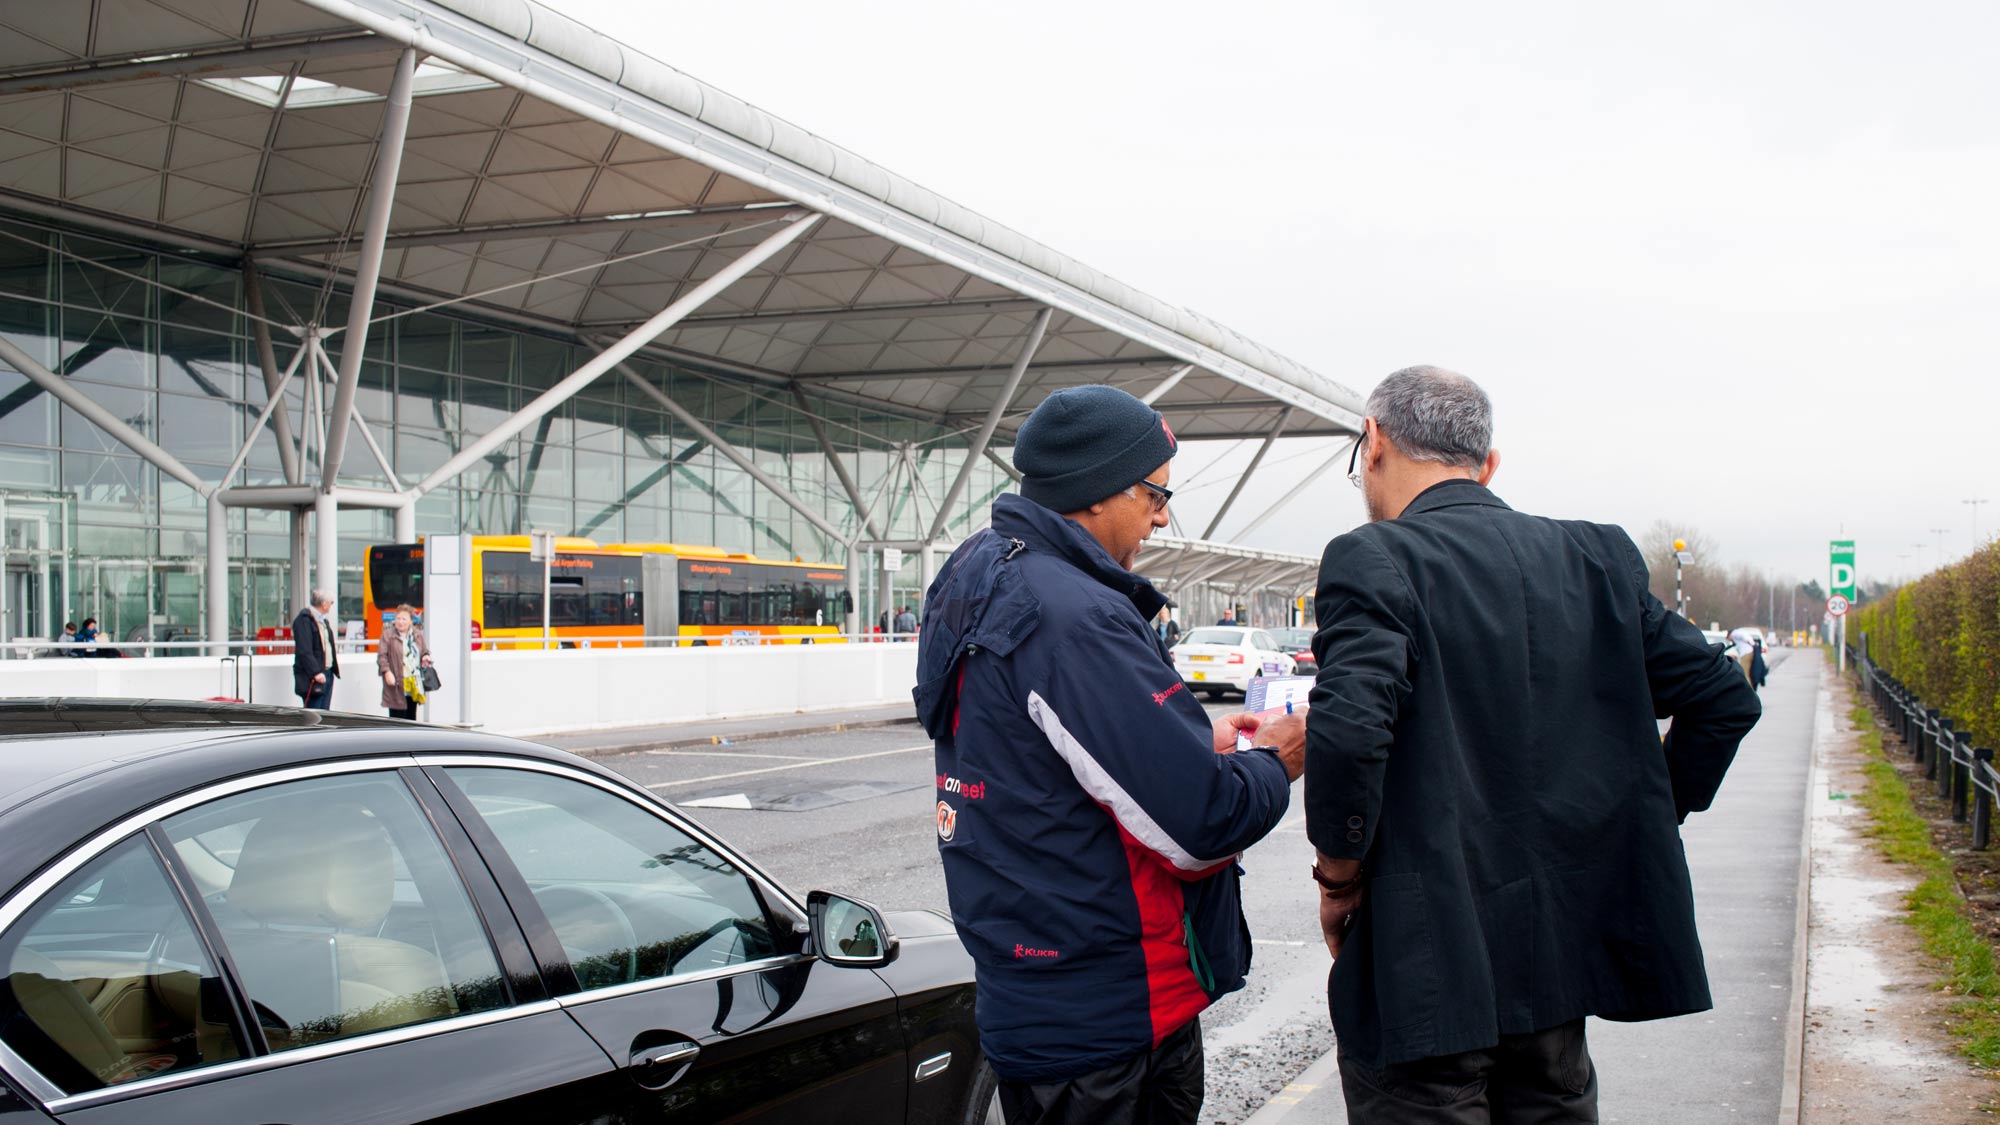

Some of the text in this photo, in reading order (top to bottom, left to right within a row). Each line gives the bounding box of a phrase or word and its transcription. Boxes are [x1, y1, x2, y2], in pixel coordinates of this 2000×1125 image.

[1831, 544, 1855, 554] Zone
[1831, 563, 1854, 589] D
[1830, 601, 1846, 610] 20
[816, 609, 823, 626] 6
[1025, 947, 1059, 958] KUKRI
